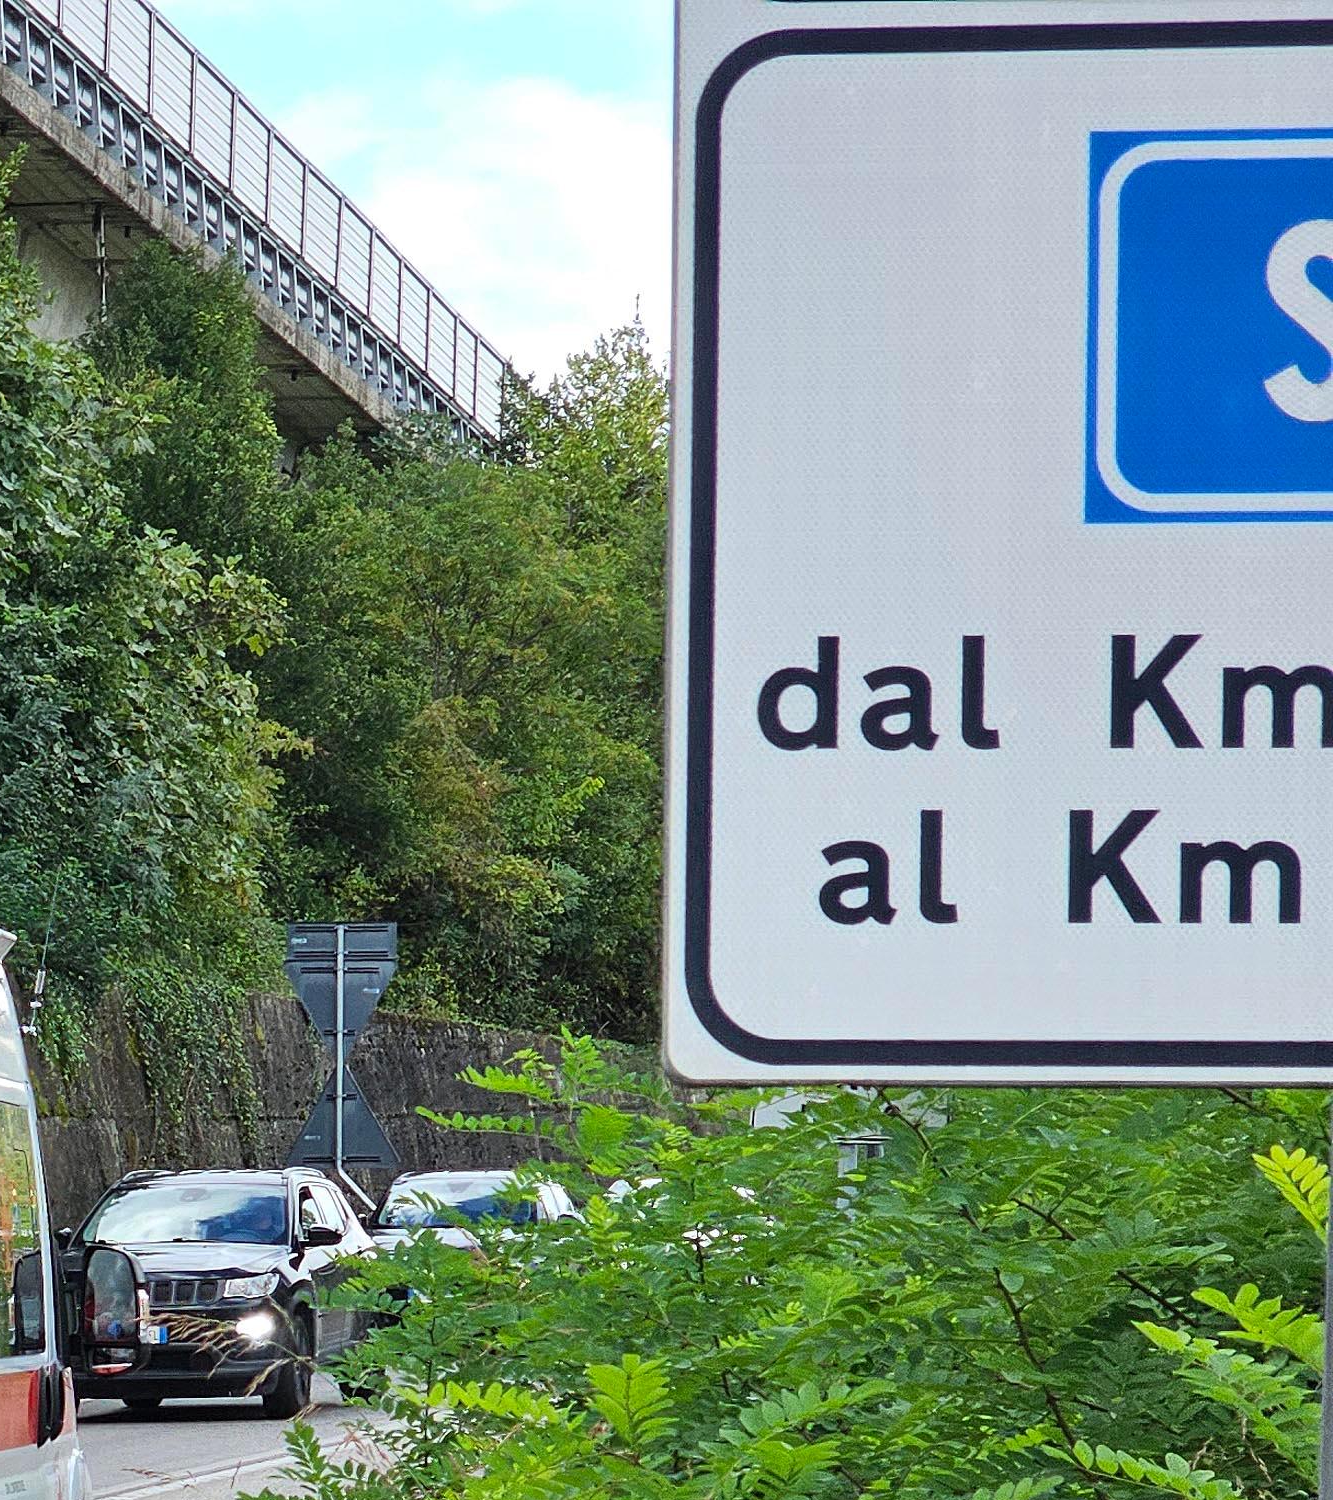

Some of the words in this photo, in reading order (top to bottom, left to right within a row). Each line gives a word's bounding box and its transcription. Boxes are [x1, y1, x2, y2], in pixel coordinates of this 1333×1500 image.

[757, 635, 1000, 751] dal
[1110, 634, 1333, 749] Km
[819, 809, 958, 926] al
[1067, 809, 1302, 925] Km
